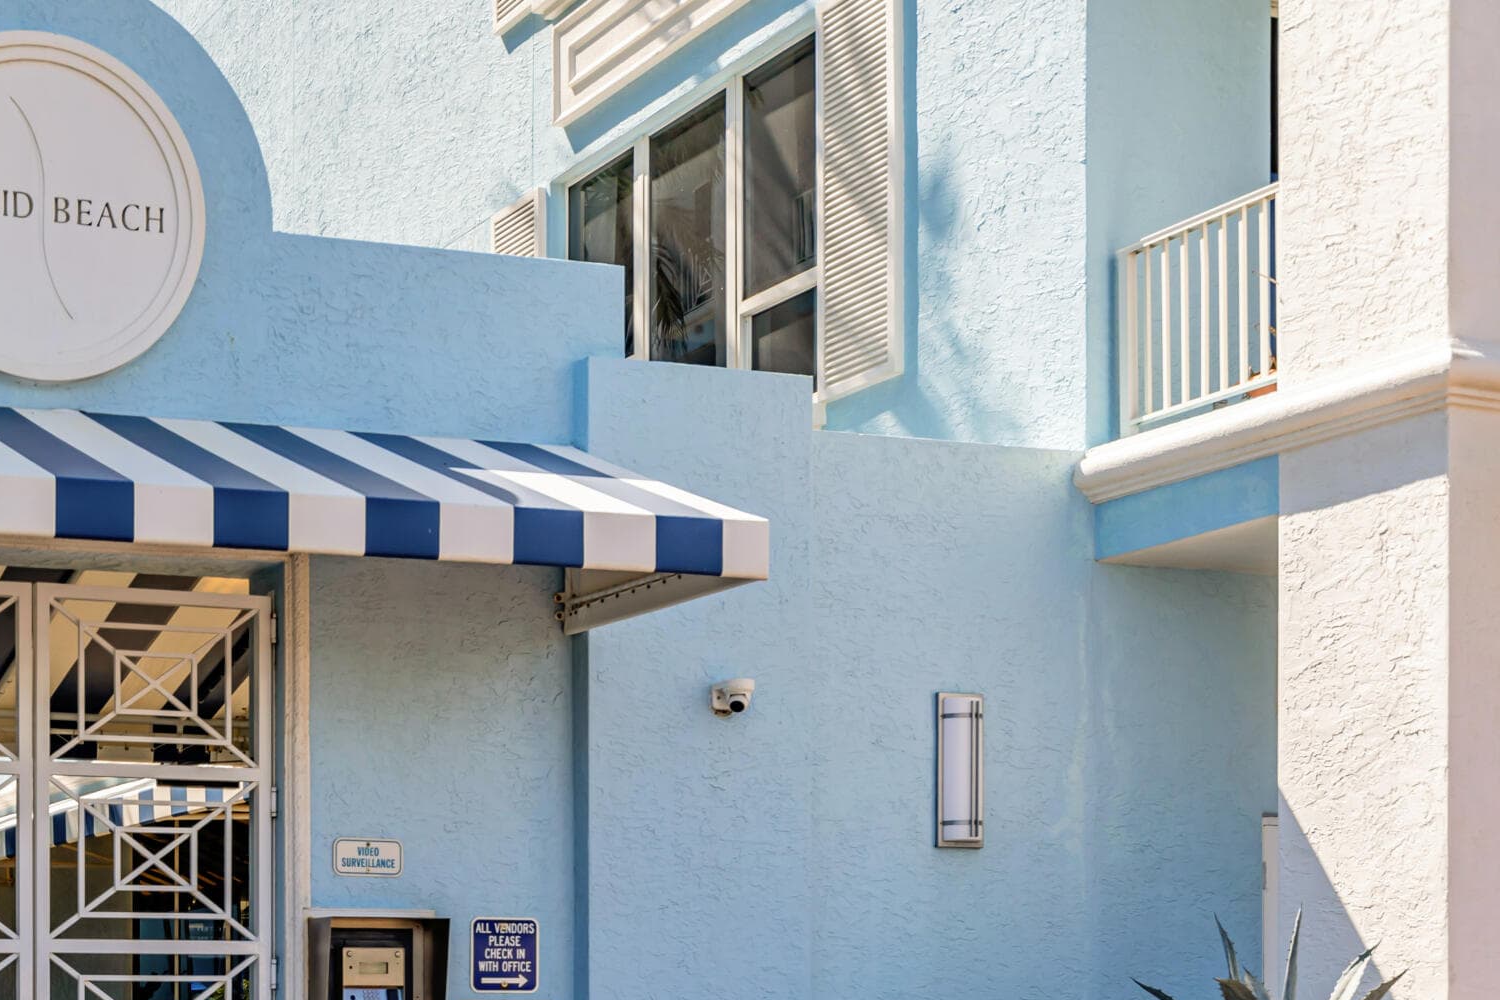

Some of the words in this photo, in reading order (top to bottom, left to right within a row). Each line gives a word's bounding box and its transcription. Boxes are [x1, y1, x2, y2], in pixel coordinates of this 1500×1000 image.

[53, 196, 165, 234] BEACH
[357, 846, 380, 856] VIDEO
[341, 857, 396, 868] SURVEILLANCE
[476, 922, 492, 934] ALL
[488, 936, 522, 946] PLEASE
[484, 948, 514, 960] CHECK
[516, 948, 526, 960] IN
[478, 960, 499, 972] WITH
[502, 960, 532, 972] OFFICE
